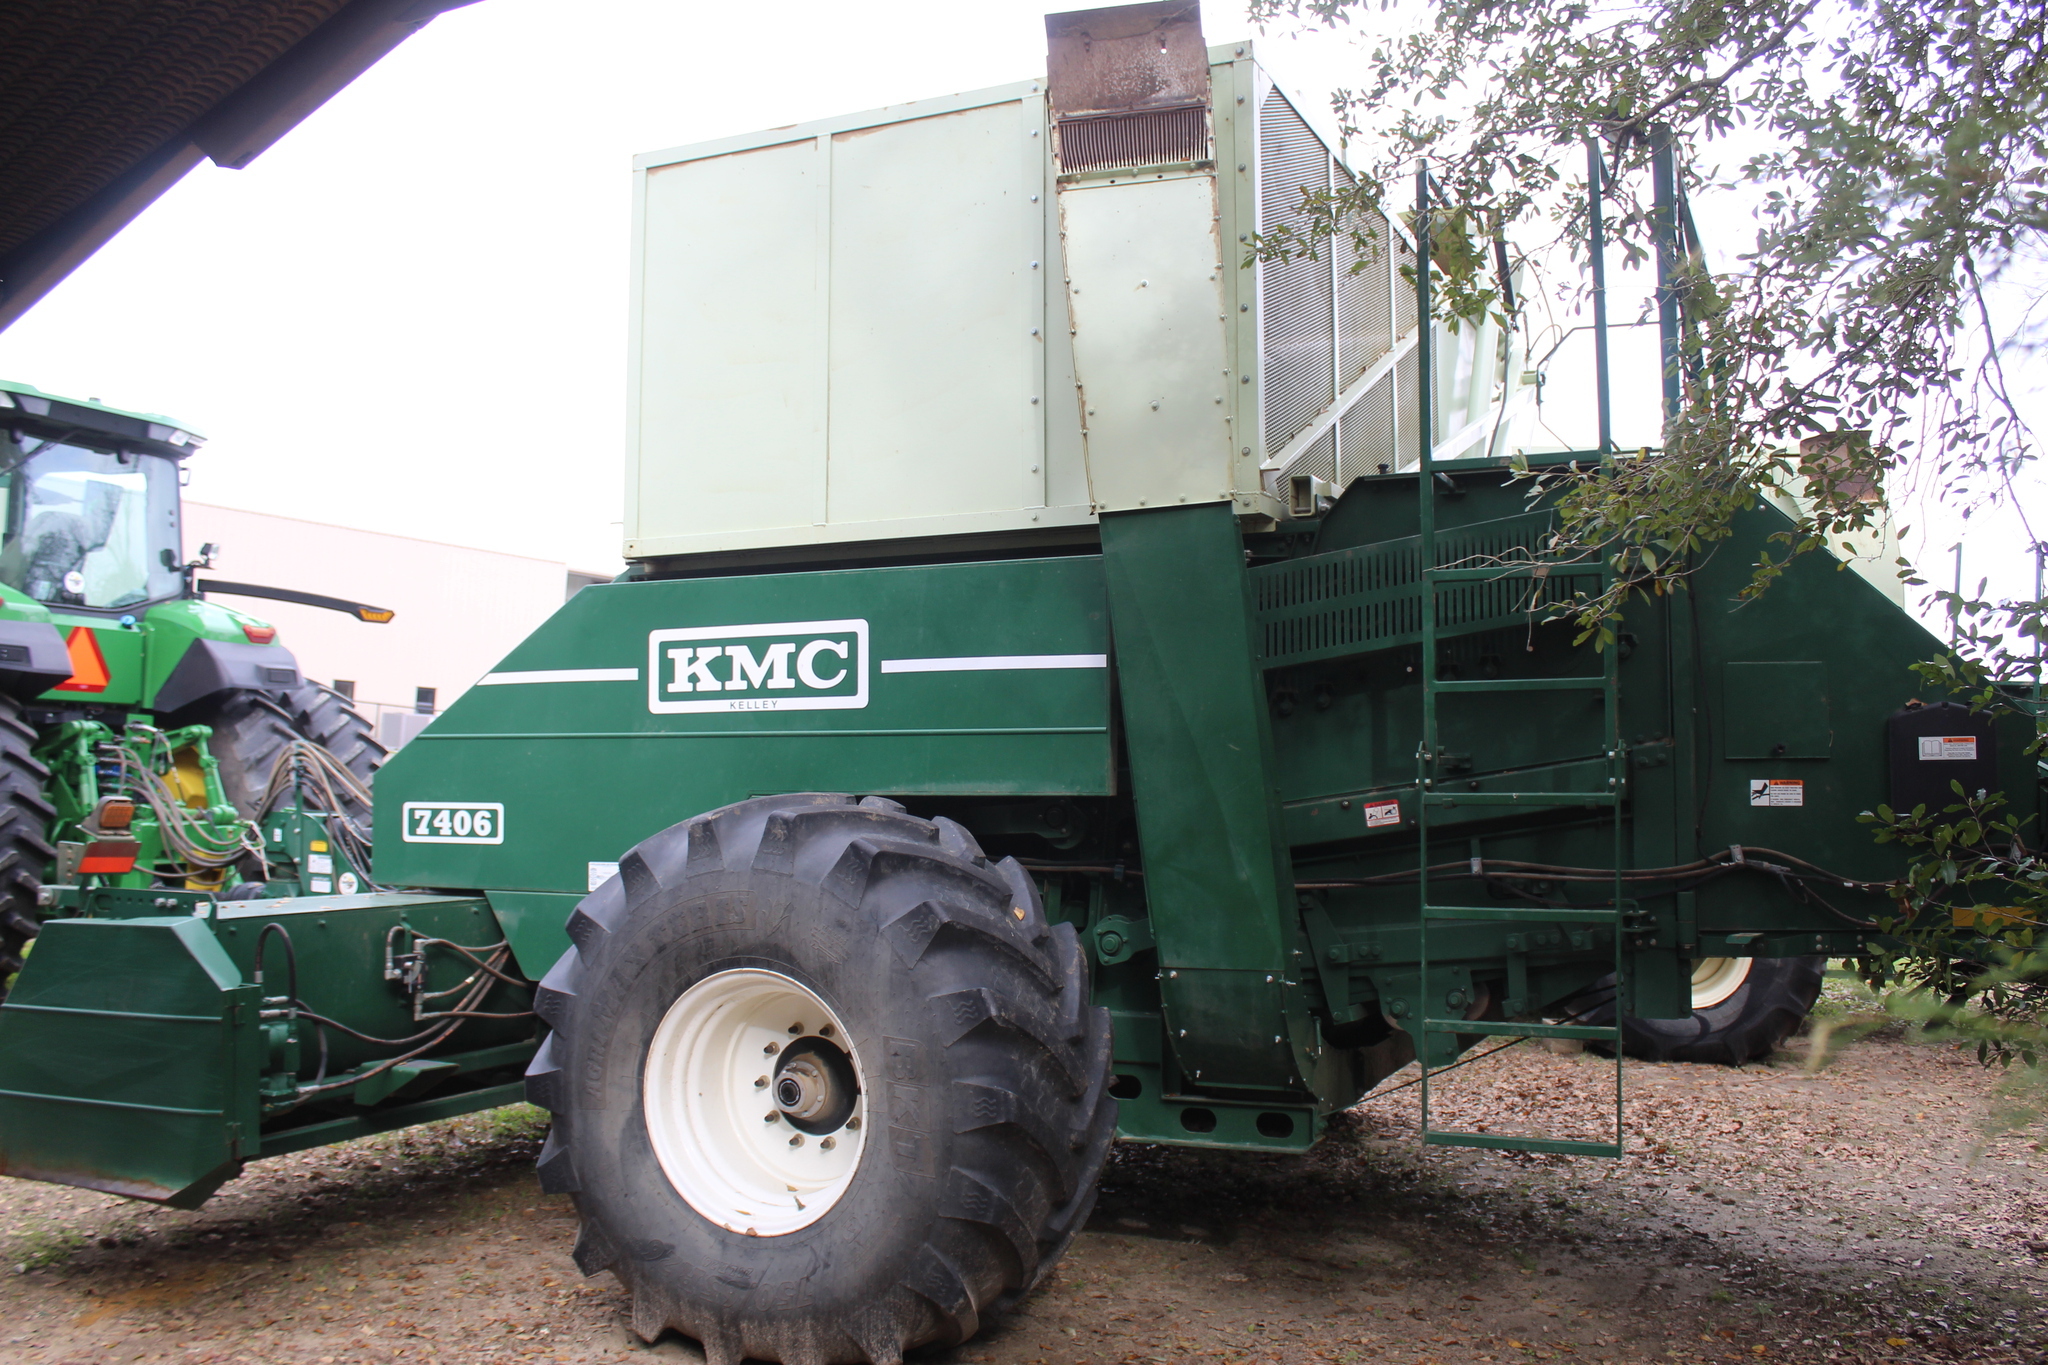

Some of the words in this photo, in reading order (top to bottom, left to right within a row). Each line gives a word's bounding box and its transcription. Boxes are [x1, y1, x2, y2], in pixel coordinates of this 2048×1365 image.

[667, 639, 848, 693] KMC
[730, 700, 778, 710] KELLEY
[414, 809, 492, 837] 7406
[887, 1039, 924, 1173] BKT
